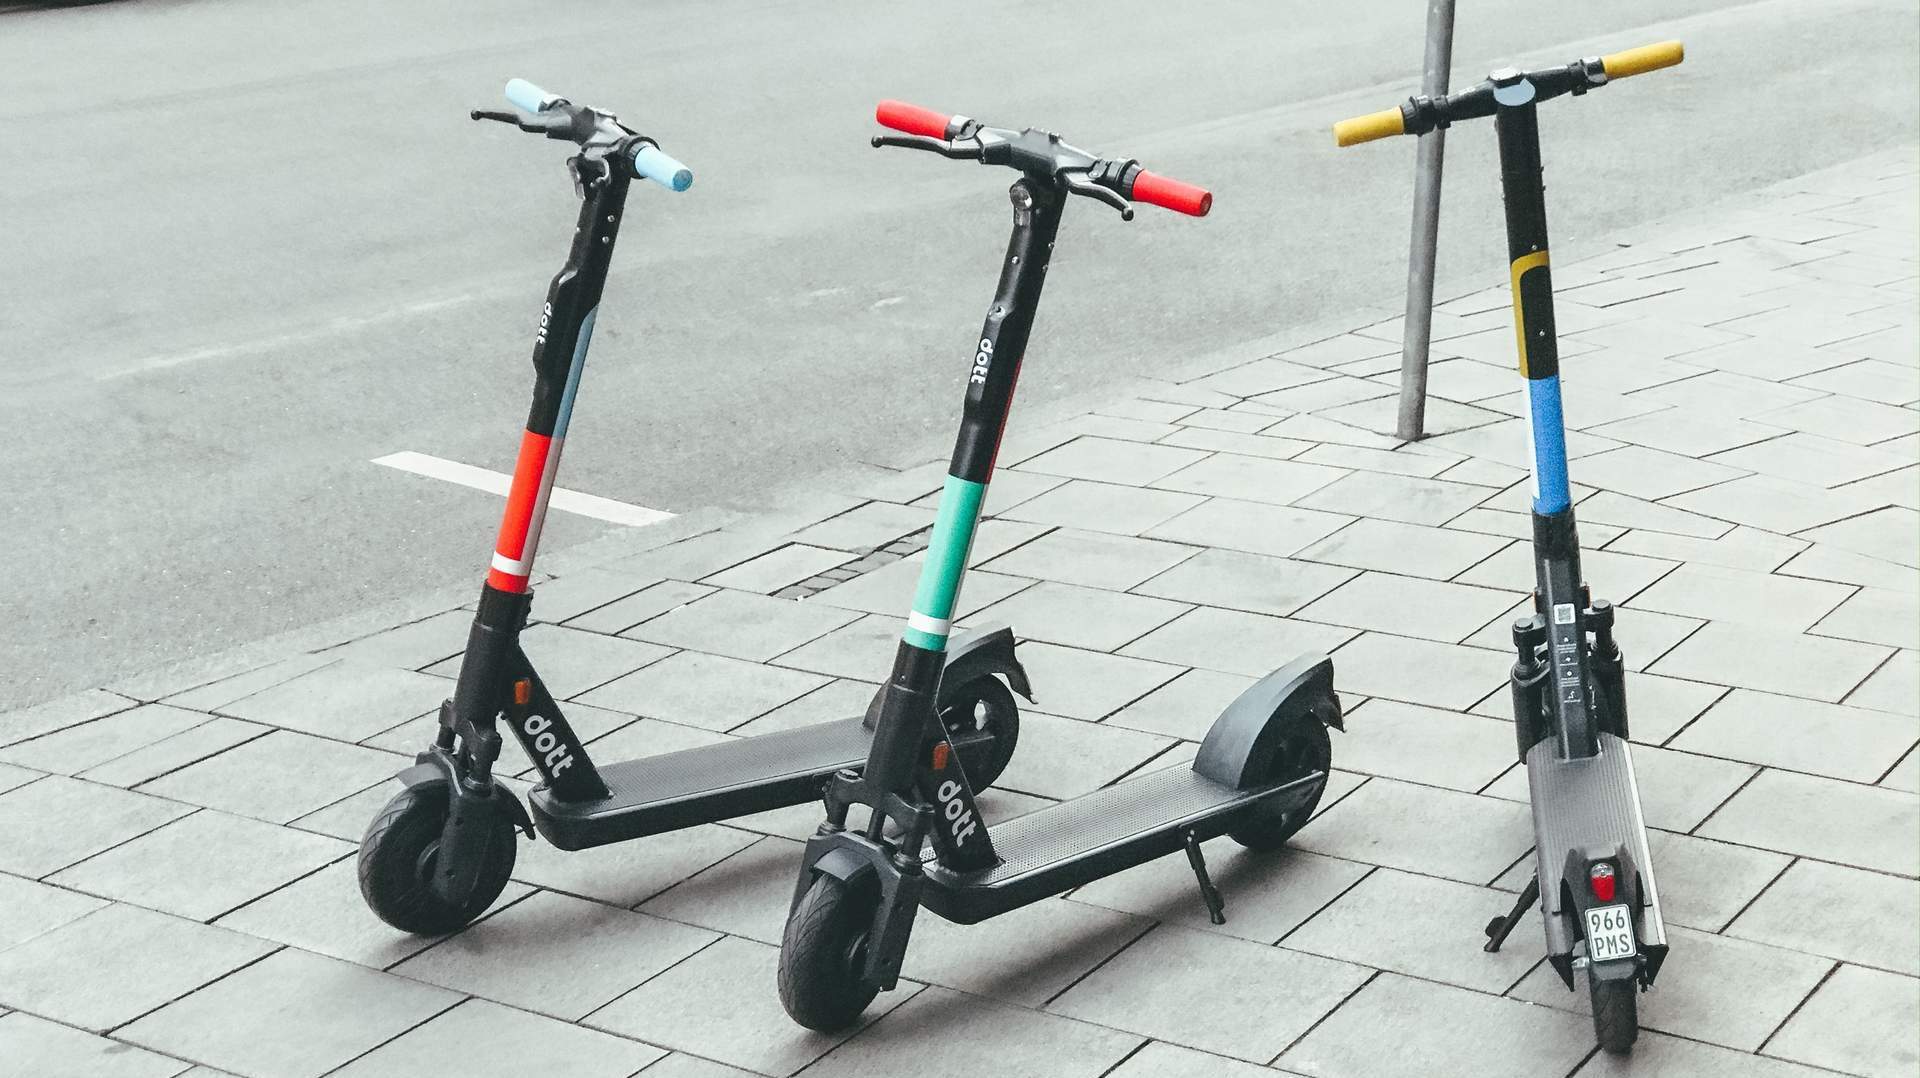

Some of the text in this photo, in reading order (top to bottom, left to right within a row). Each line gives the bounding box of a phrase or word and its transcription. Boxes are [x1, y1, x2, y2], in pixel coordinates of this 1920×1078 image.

[536, 301, 553, 344] dott
[971, 338, 994, 384] dott
[524, 714, 574, 779] dott
[937, 780, 977, 848] dott
[1591, 910, 1625, 933] 966
[1594, 934, 1630, 957] PMS
